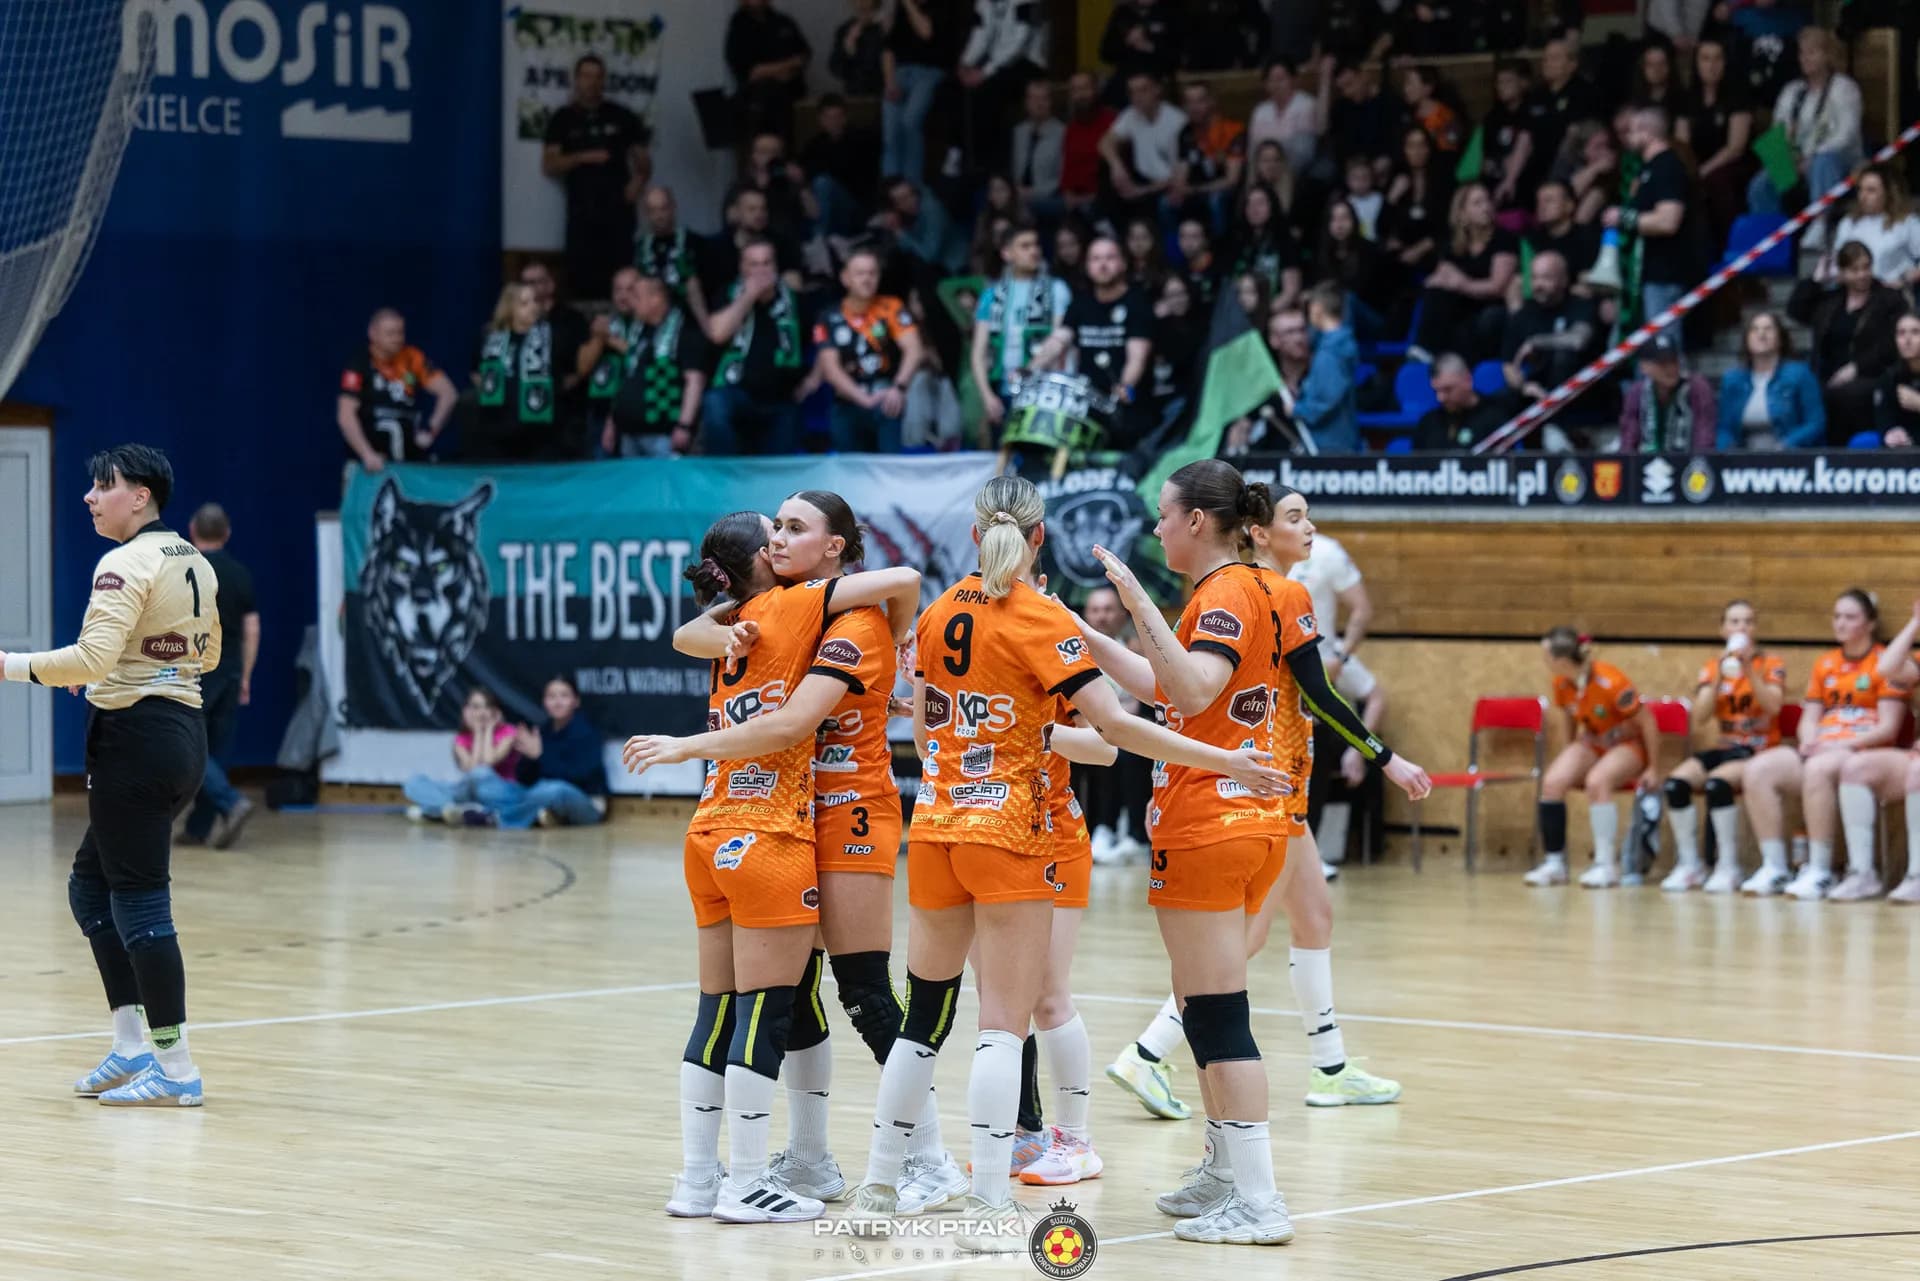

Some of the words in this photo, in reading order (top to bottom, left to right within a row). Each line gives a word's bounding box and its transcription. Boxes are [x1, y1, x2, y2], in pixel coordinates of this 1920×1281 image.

[125, 94, 241, 135] KIELCE
[185, 567, 200, 618] 1
[500, 542, 578, 640] THE
[590, 540, 691, 641] BEST
[1204, 614, 1236, 631] elmas
[151, 638, 184, 652] elmas
[824, 643, 857, 660] elmas
[943, 612, 974, 677] 9
[958, 692, 1014, 730] KPS
[955, 786, 1003, 795] GOLIAT
[851, 806, 869, 837] 3
[844, 844, 873, 855] TICO
